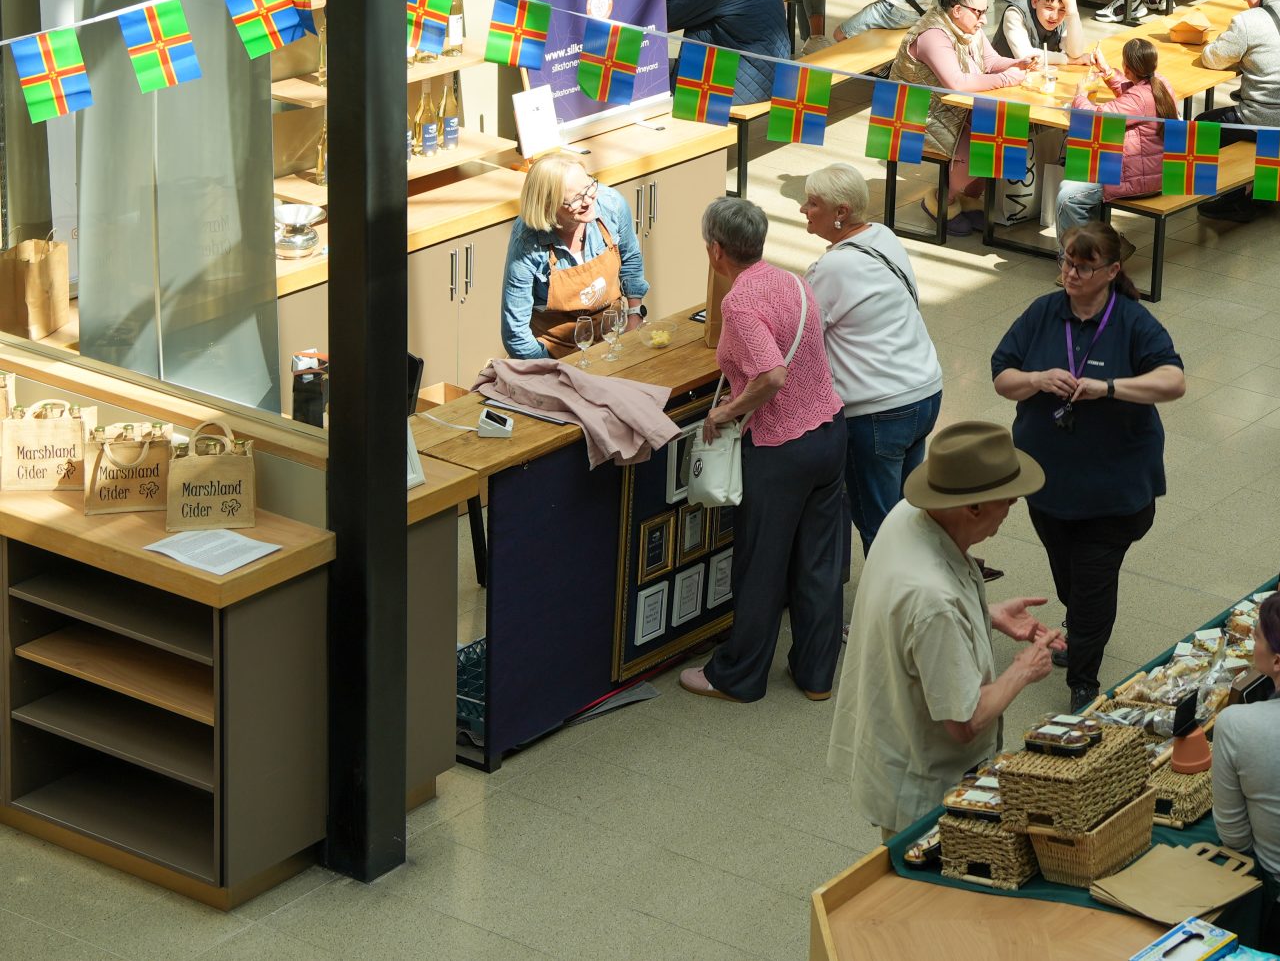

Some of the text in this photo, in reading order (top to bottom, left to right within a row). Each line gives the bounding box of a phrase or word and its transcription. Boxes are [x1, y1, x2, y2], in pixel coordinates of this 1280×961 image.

[17, 444, 76, 459] Marshland
[17, 465, 48, 480] Cider
[99, 463, 159, 480] Marshland
[99, 485, 130, 500] Cider
[182, 480, 242, 497] Marshland
[181, 503, 212, 518] Cider
